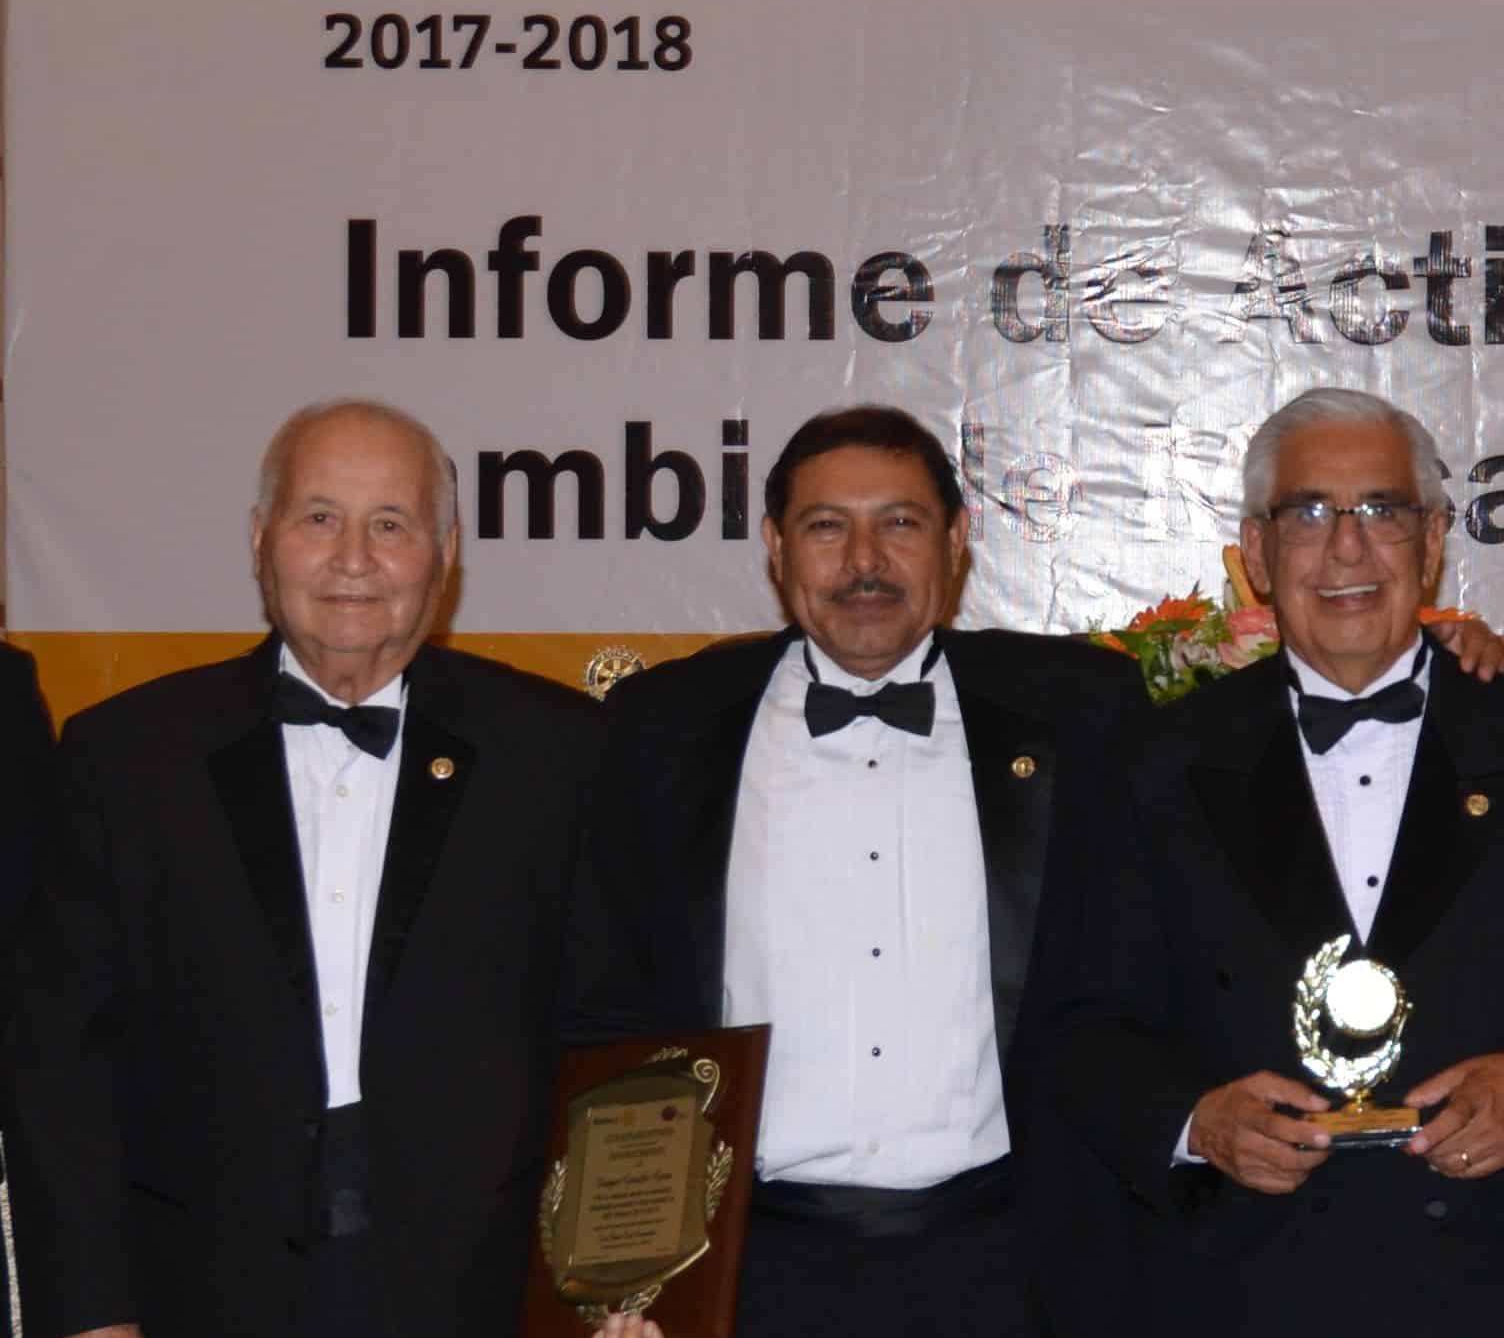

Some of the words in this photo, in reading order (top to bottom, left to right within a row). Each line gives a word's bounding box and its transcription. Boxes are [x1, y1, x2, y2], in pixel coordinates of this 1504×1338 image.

[323, 11, 693, 73] 2017-2018
[346, 215, 936, 343] Informe
[991, 223, 1168, 343] de
[477, 419, 749, 543] mbi
